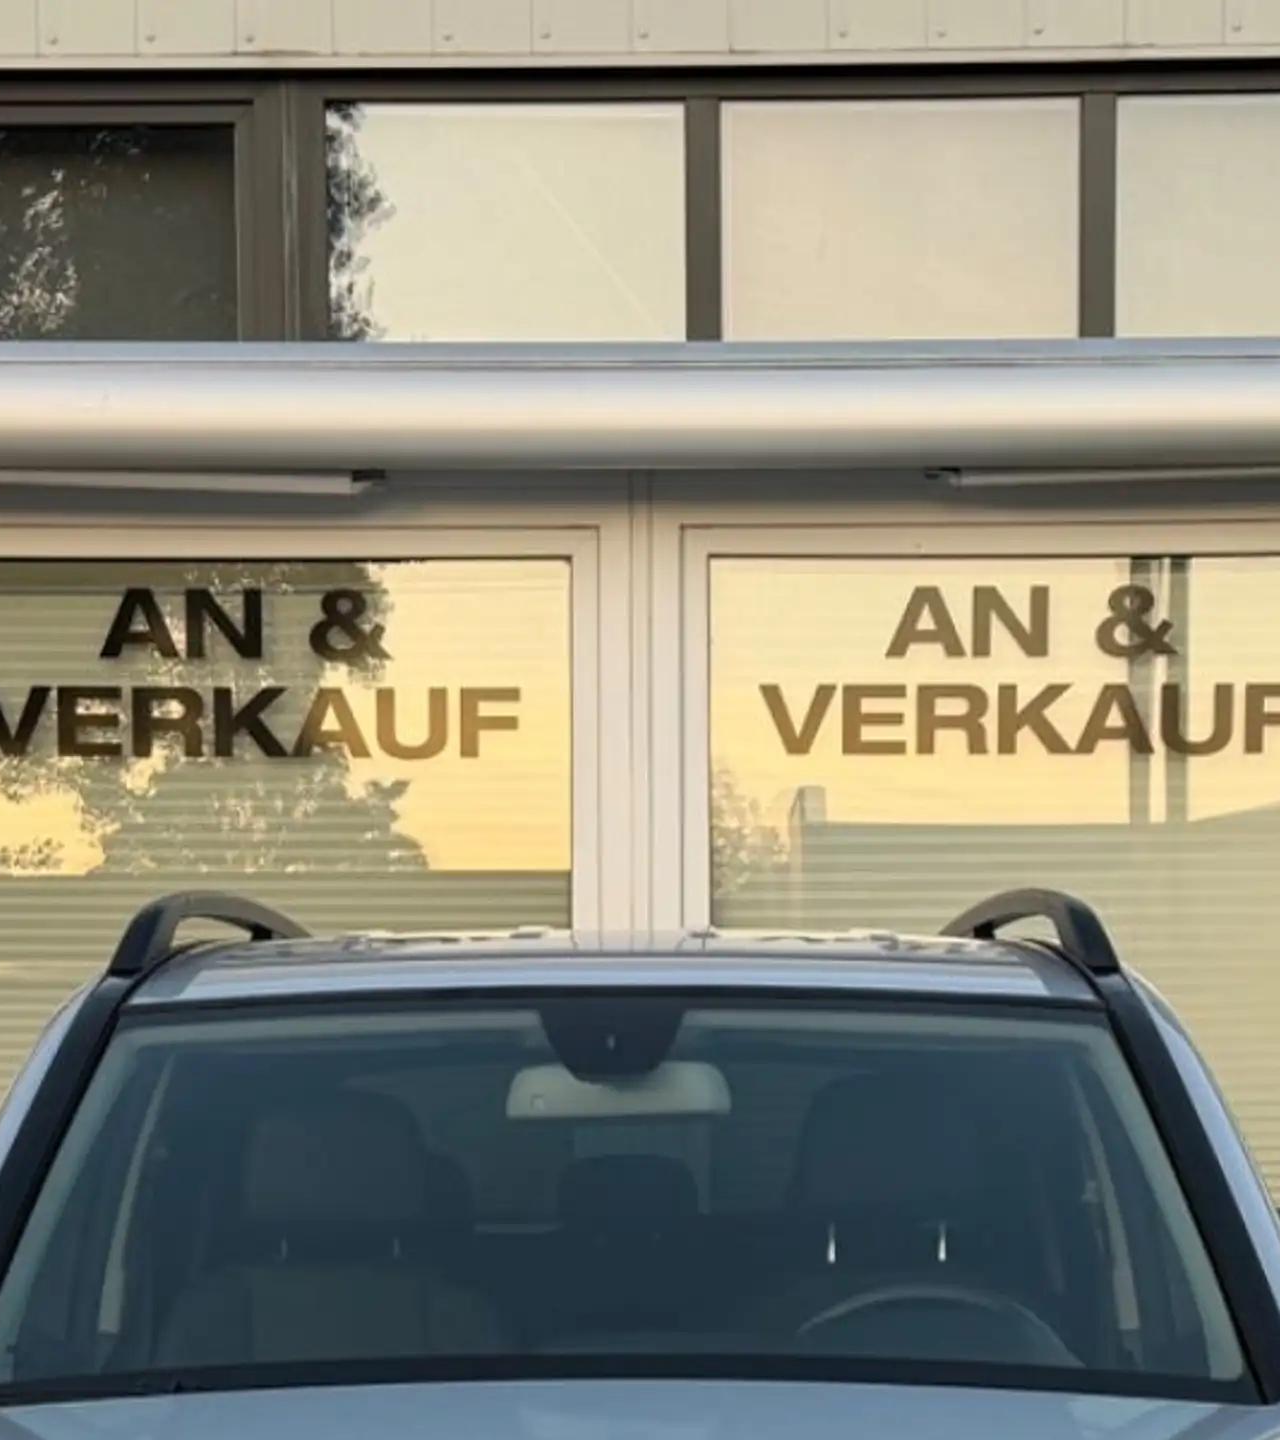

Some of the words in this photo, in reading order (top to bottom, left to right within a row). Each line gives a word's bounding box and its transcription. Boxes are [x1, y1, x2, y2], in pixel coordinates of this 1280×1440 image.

[99, 586, 263, 659] AN
[308, 586, 393, 661] &
[884, 585, 1051, 658] AN
[1094, 584, 1179, 659] &
